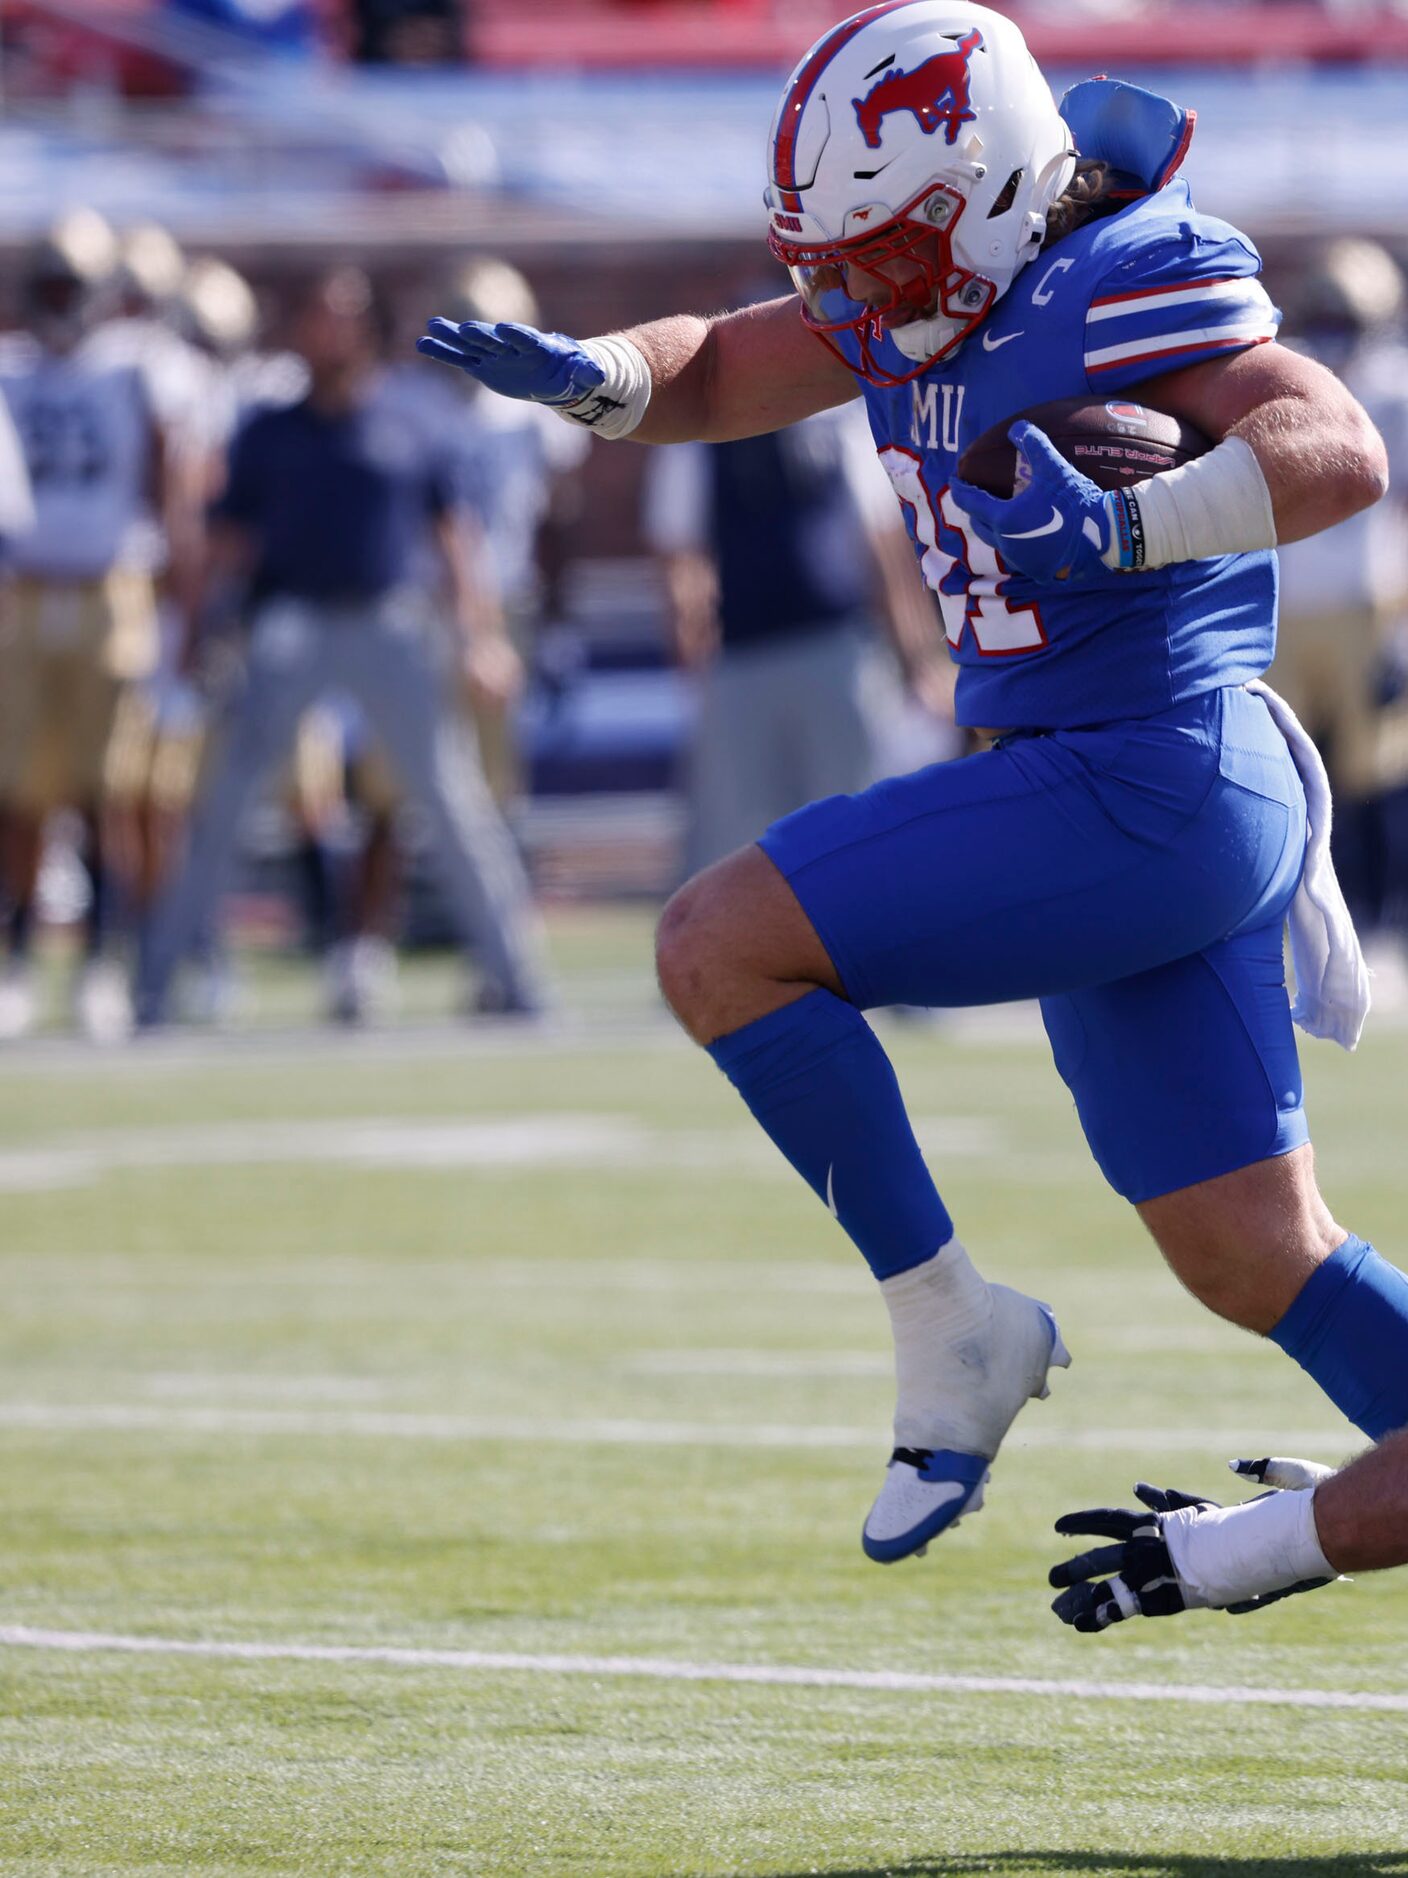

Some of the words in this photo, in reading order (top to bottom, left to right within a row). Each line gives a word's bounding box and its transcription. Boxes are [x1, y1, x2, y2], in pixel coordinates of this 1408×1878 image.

[774, 212, 803, 233] SMU
[1031, 257, 1075, 306] C
[911, 379, 965, 453] MU
[1074, 445, 1123, 458] ELITE
[1124, 448, 1176, 468] VAPOR
[1128, 501, 1139, 520] CAN
